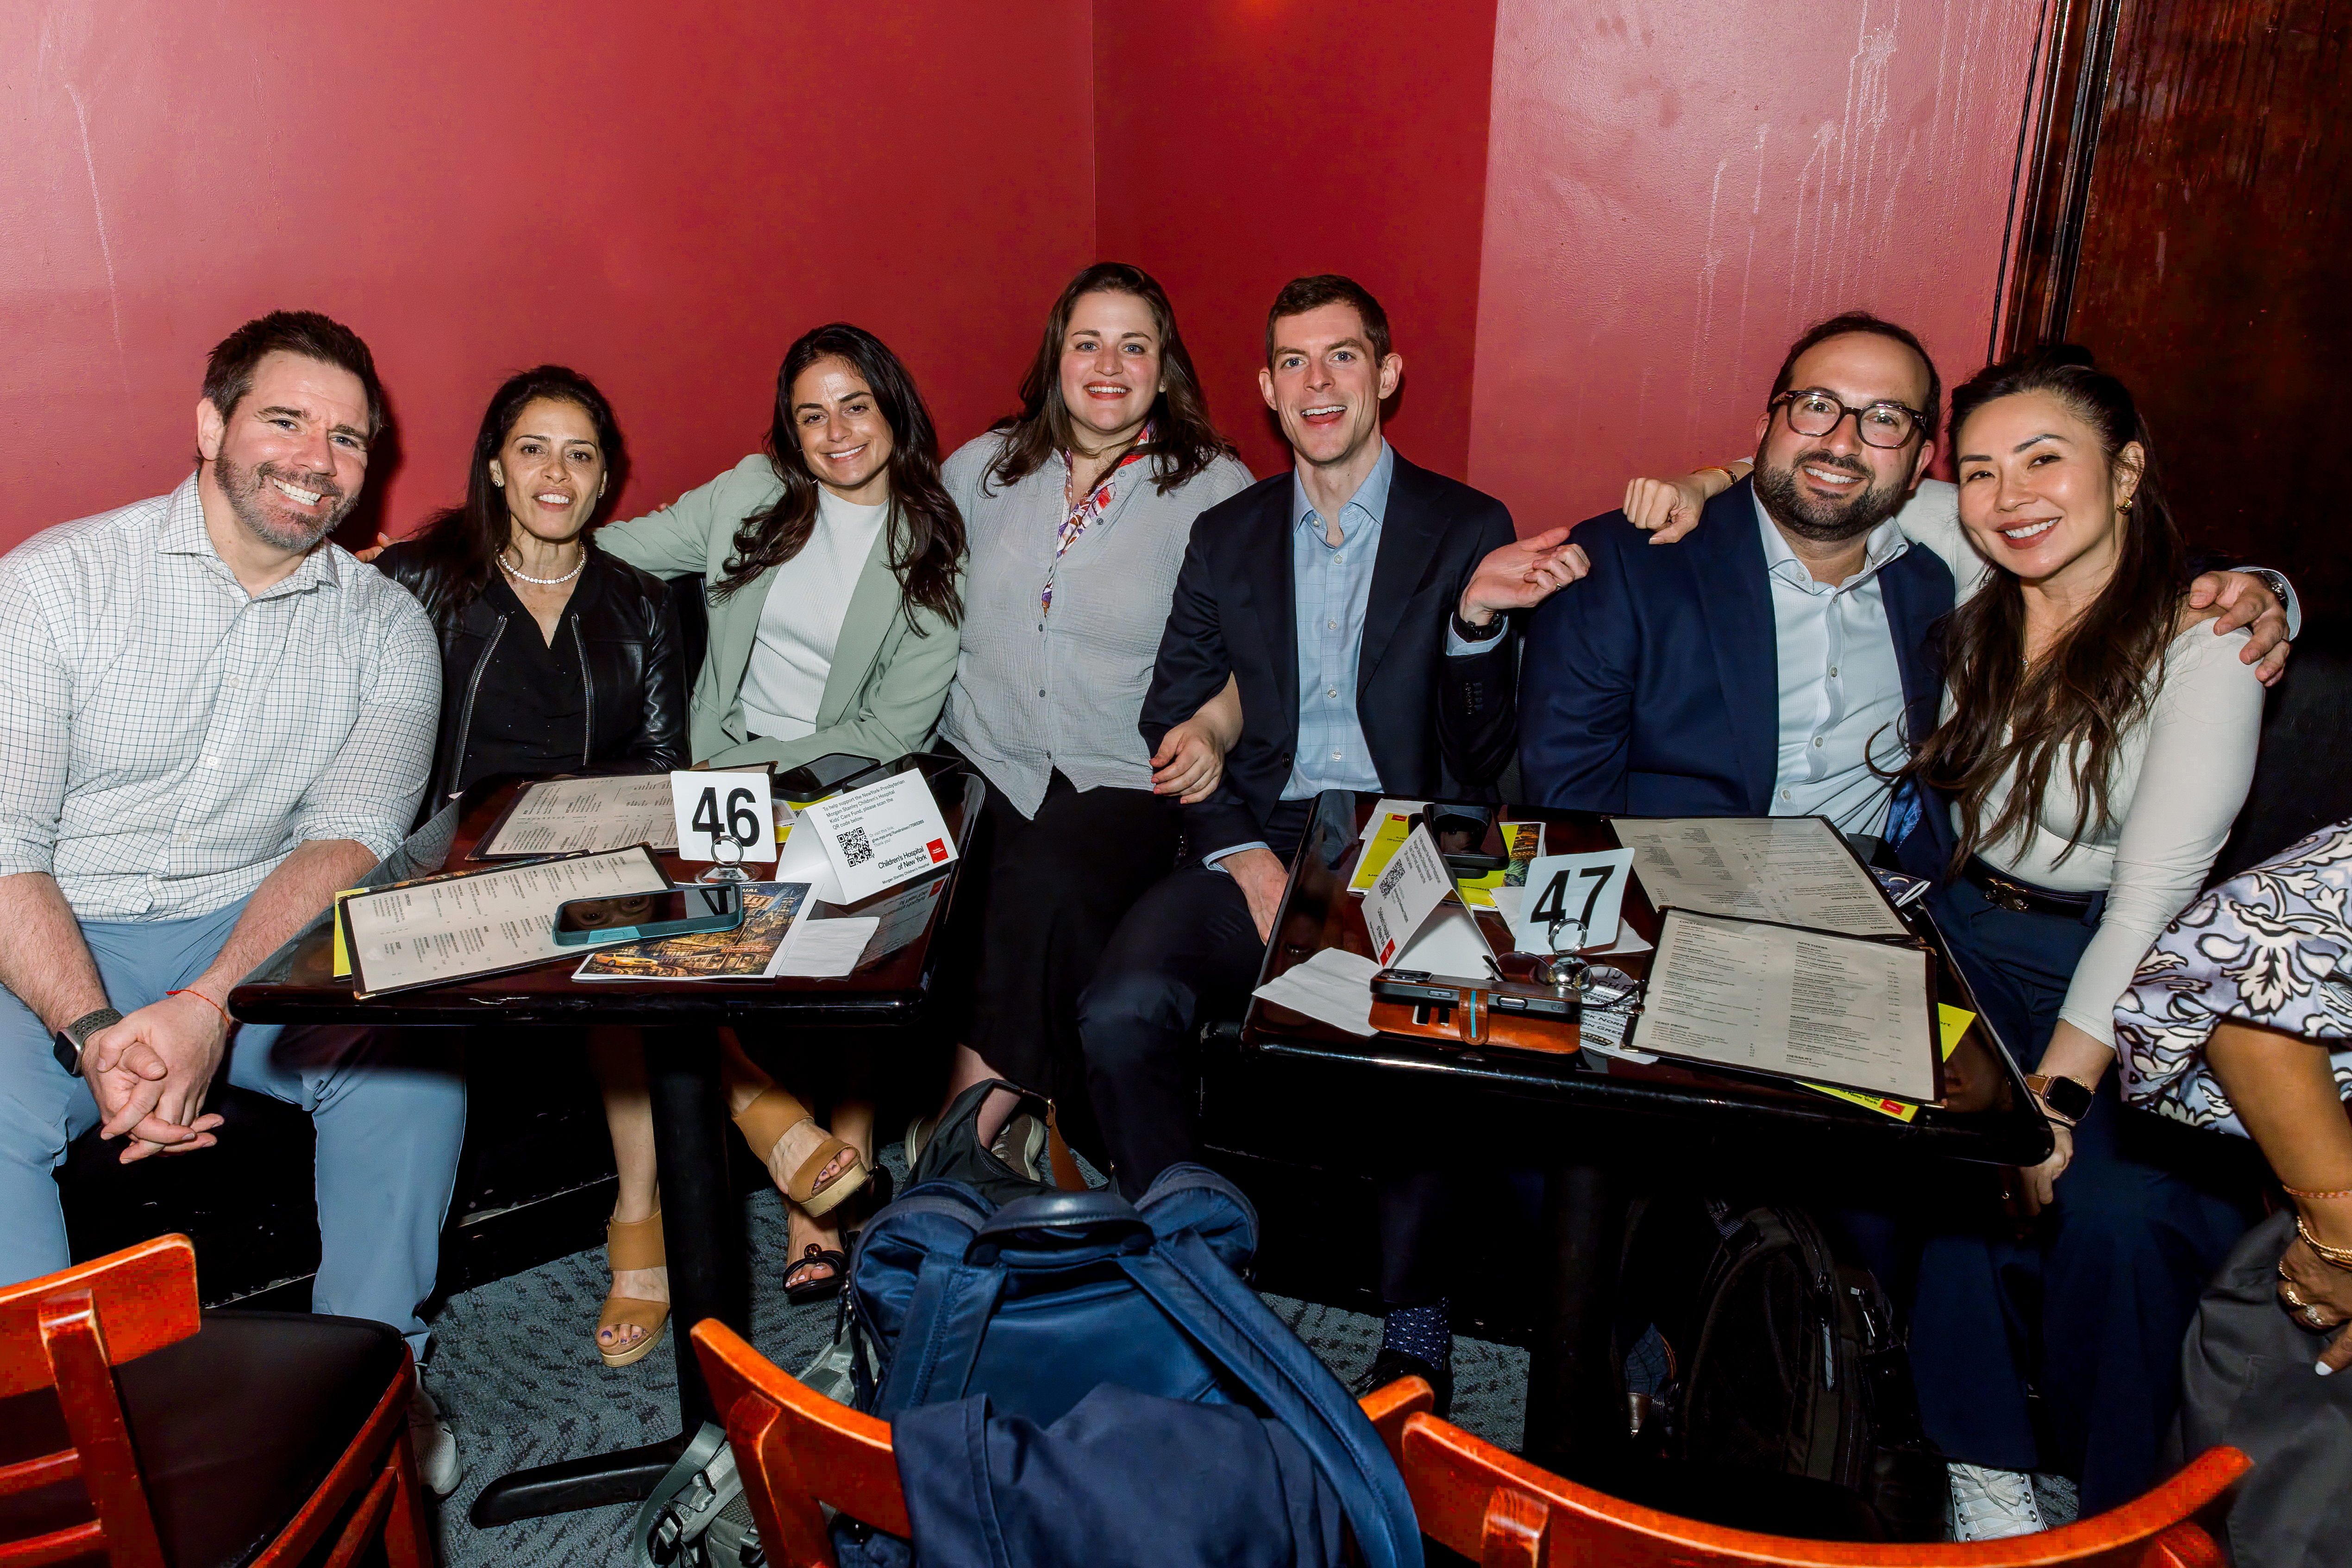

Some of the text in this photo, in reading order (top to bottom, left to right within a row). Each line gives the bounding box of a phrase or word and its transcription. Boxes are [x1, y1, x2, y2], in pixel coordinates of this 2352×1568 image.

[826, 790, 895, 818] Morgan Stanley Children's Hospital
[839, 797, 854, 806] support
[862, 780, 905, 798] NewYork-Presbyterian
[692, 787, 760, 847] 46
[851, 808, 863, 816] Fund,
[863, 804, 877, 812] please
[878, 855, 903, 869] Children's
[903, 846, 924, 859] Hospital
[915, 854, 928, 862] York
[1530, 865, 1616, 933] 47
